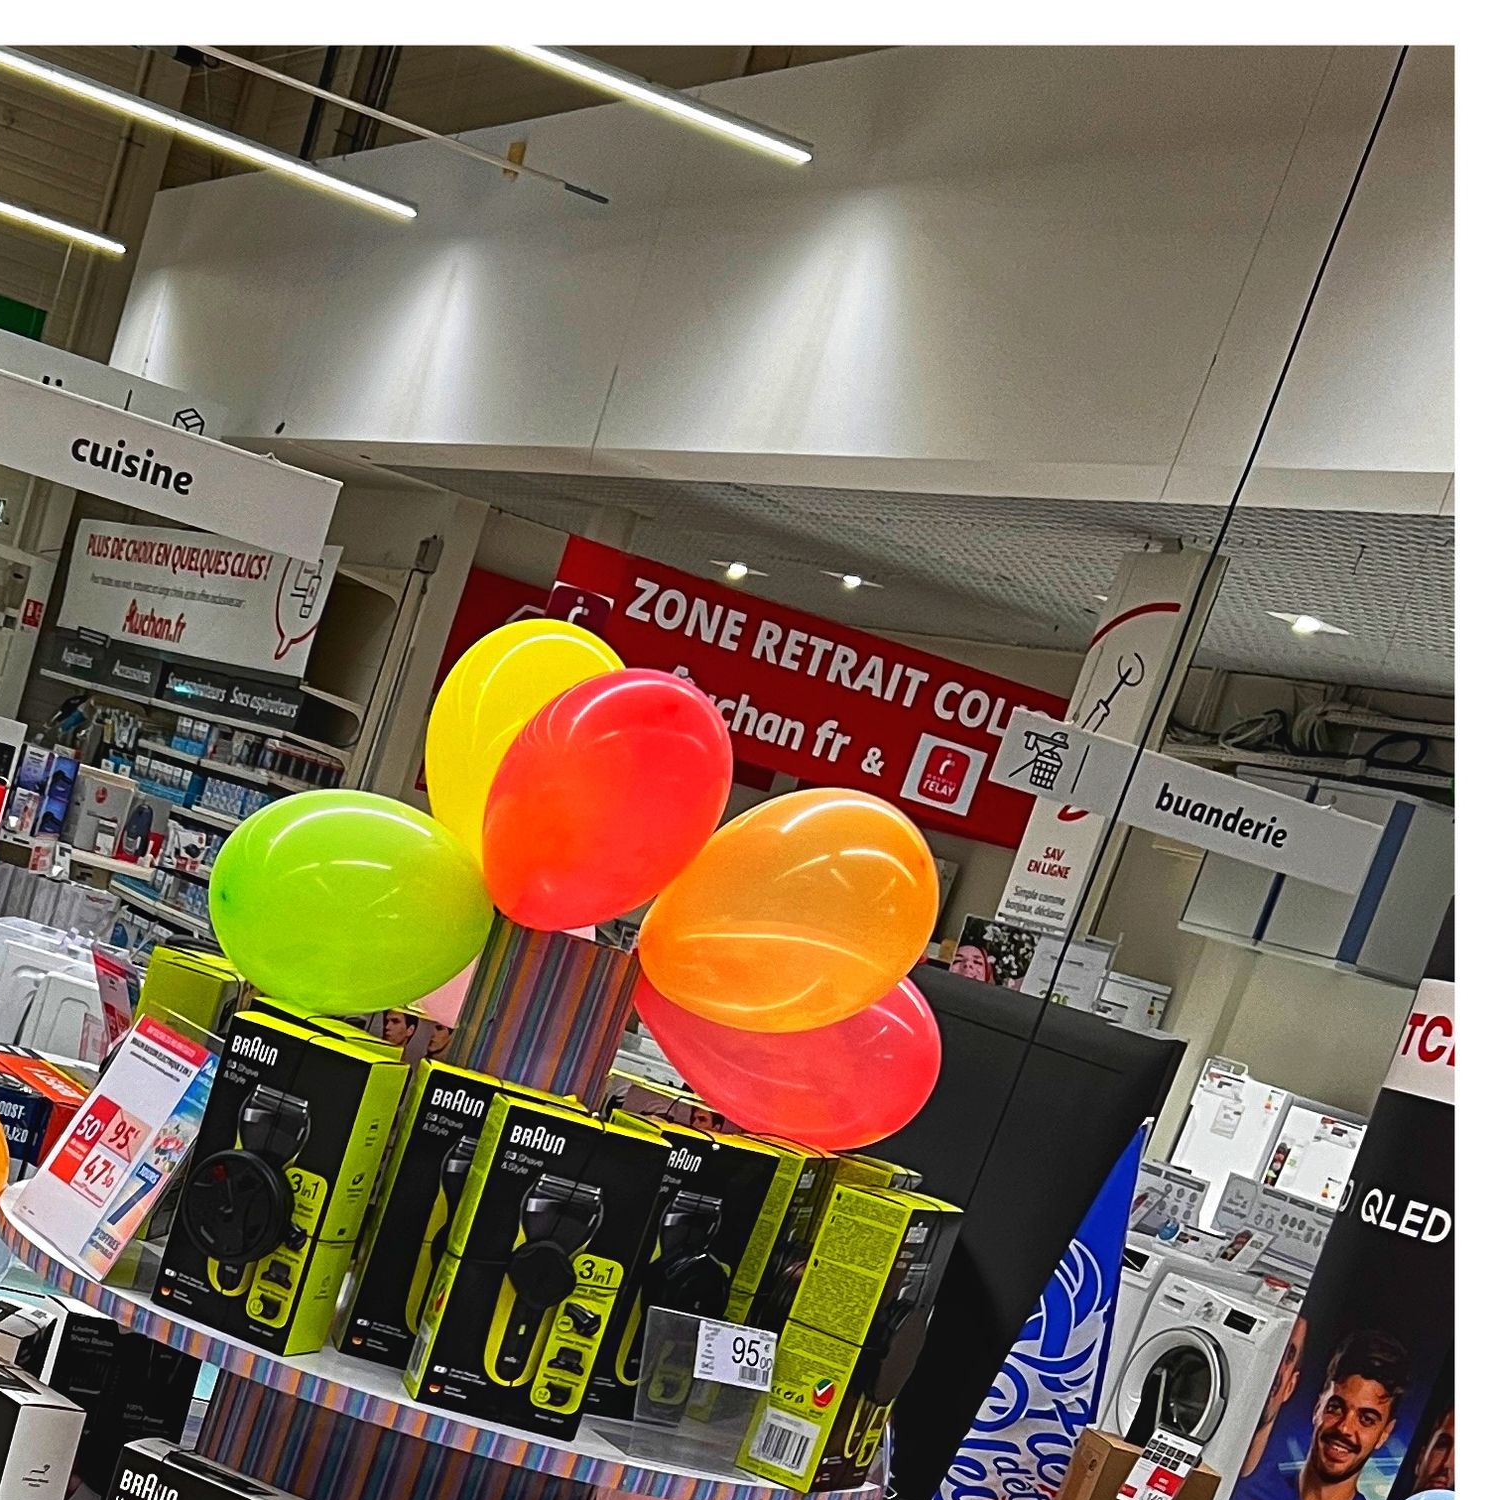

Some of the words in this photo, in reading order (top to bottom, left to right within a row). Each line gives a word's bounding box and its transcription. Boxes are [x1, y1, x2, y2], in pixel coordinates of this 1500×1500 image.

[70, 436, 193, 496] cuisine
[87, 533, 112, 558] PLUS
[125, 540, 155, 564] CHOIX
[154, 544, 171, 567] EN
[171, 545, 229, 577] QUELQUES
[230, 553, 266, 580] CLICS
[122, 599, 187, 644] Auchan.fr
[625, 576, 753, 652] ZONE
[752, 619, 928, 708] RETRAIT
[861, 747, 884, 777] &
[1155, 783, 1288, 848] buanderie
[1027, 859, 1041, 873] EN
[1041, 863, 1071, 879] LIGNE
[1043, 846, 1066, 861] SAV
[231, 1035, 278, 1067] BRAUN
[1401, 1011, 1455, 1067] TC
[430, 1088, 485, 1118] BRAUN
[509, 1125, 566, 1156] BRAUN
[666, 1148, 701, 1173] RAUN
[1360, 1188, 1452, 1243] QLED
[731, 1337, 760, 1367] 95
